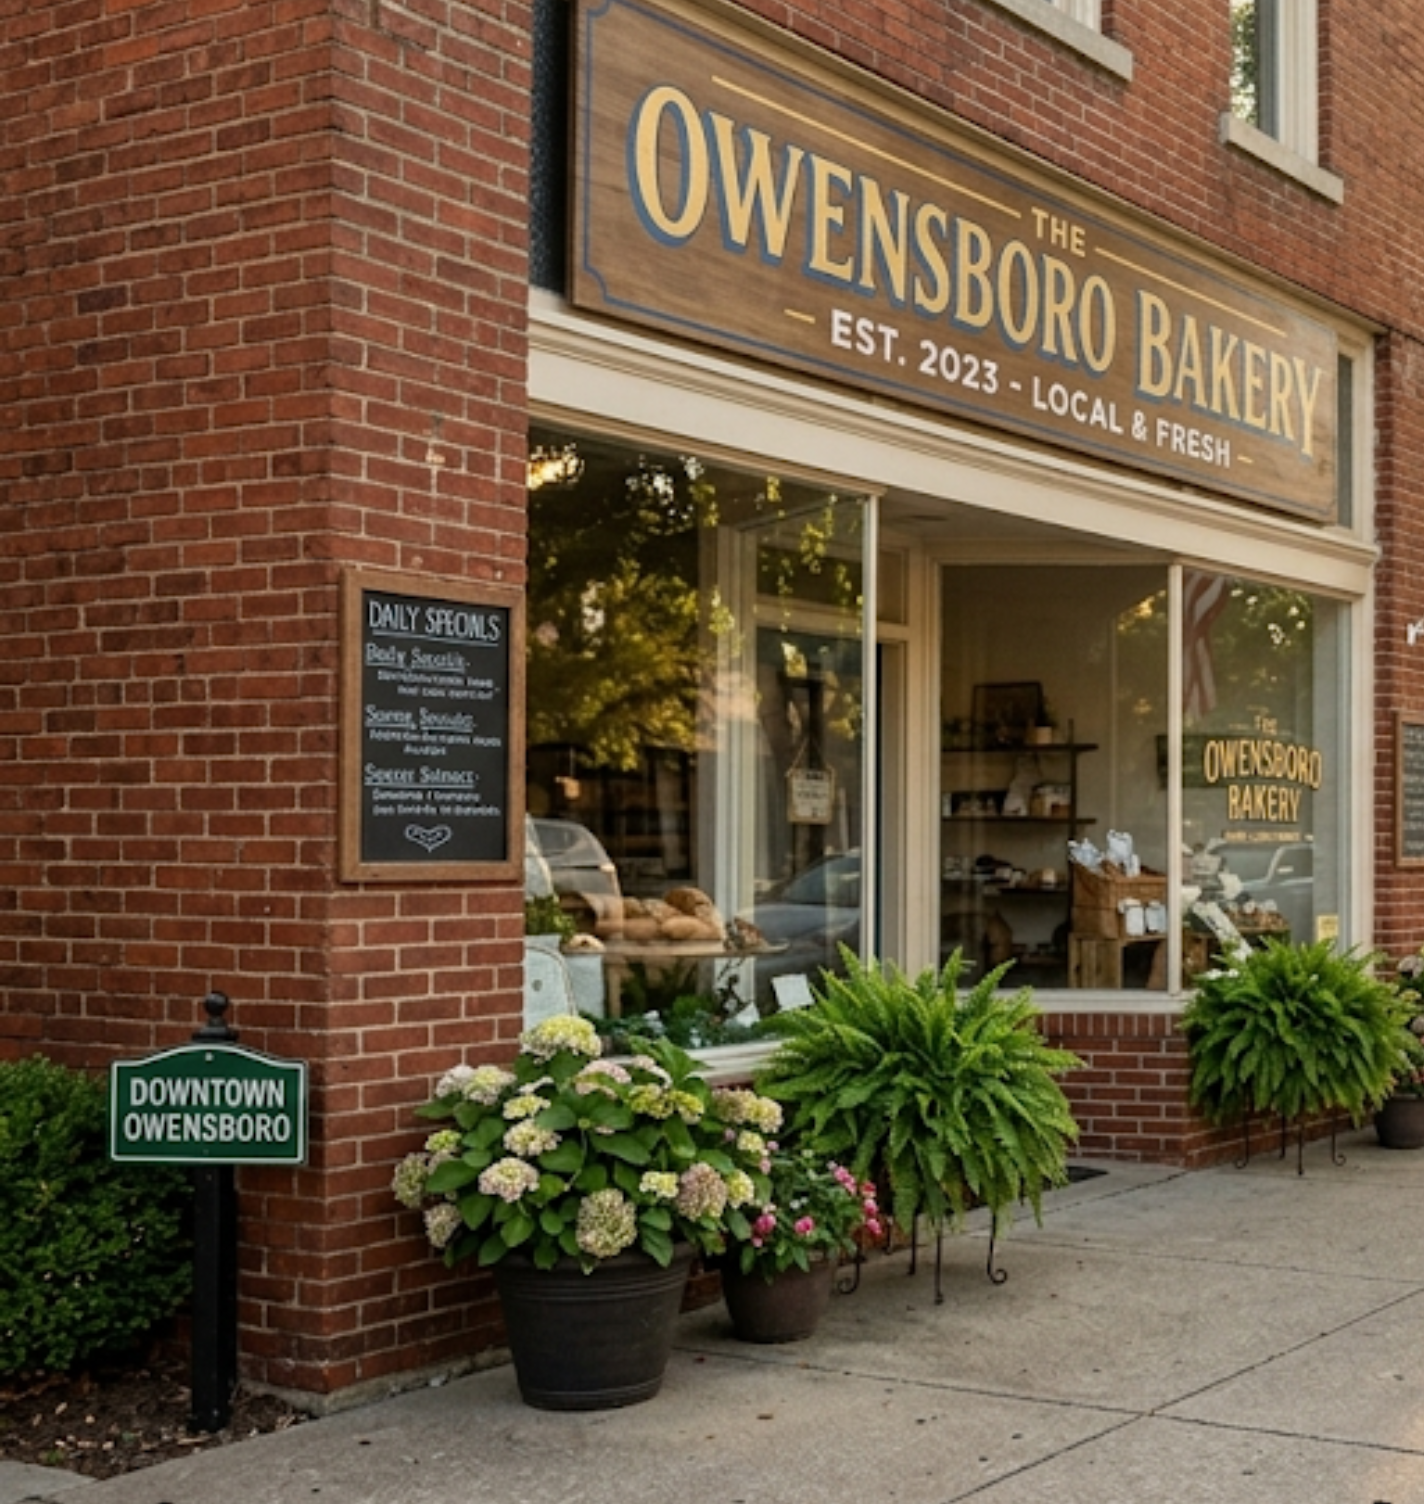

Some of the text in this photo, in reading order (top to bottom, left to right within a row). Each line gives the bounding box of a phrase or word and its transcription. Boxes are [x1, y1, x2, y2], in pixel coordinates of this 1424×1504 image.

[1030, 207, 1087, 258] THE
[627, 85, 1324, 460] OWENSBORO BAKERY
[830, 309, 906, 366] EST.
[919, 339, 999, 395] 2023
[1032, 376, 1124, 436] LOCAL
[1131, 408, 1148, 441] &
[1156, 418, 1231, 468] FRESH
[369, 600, 420, 632] DAILY
[1204, 740, 1322, 789] OWENSBORO
[1228, 784, 1301, 822] BAKERY
[130, 1077, 284, 1107] DOWNTOWN
[124, 1113, 291, 1142] OWENSBORO
